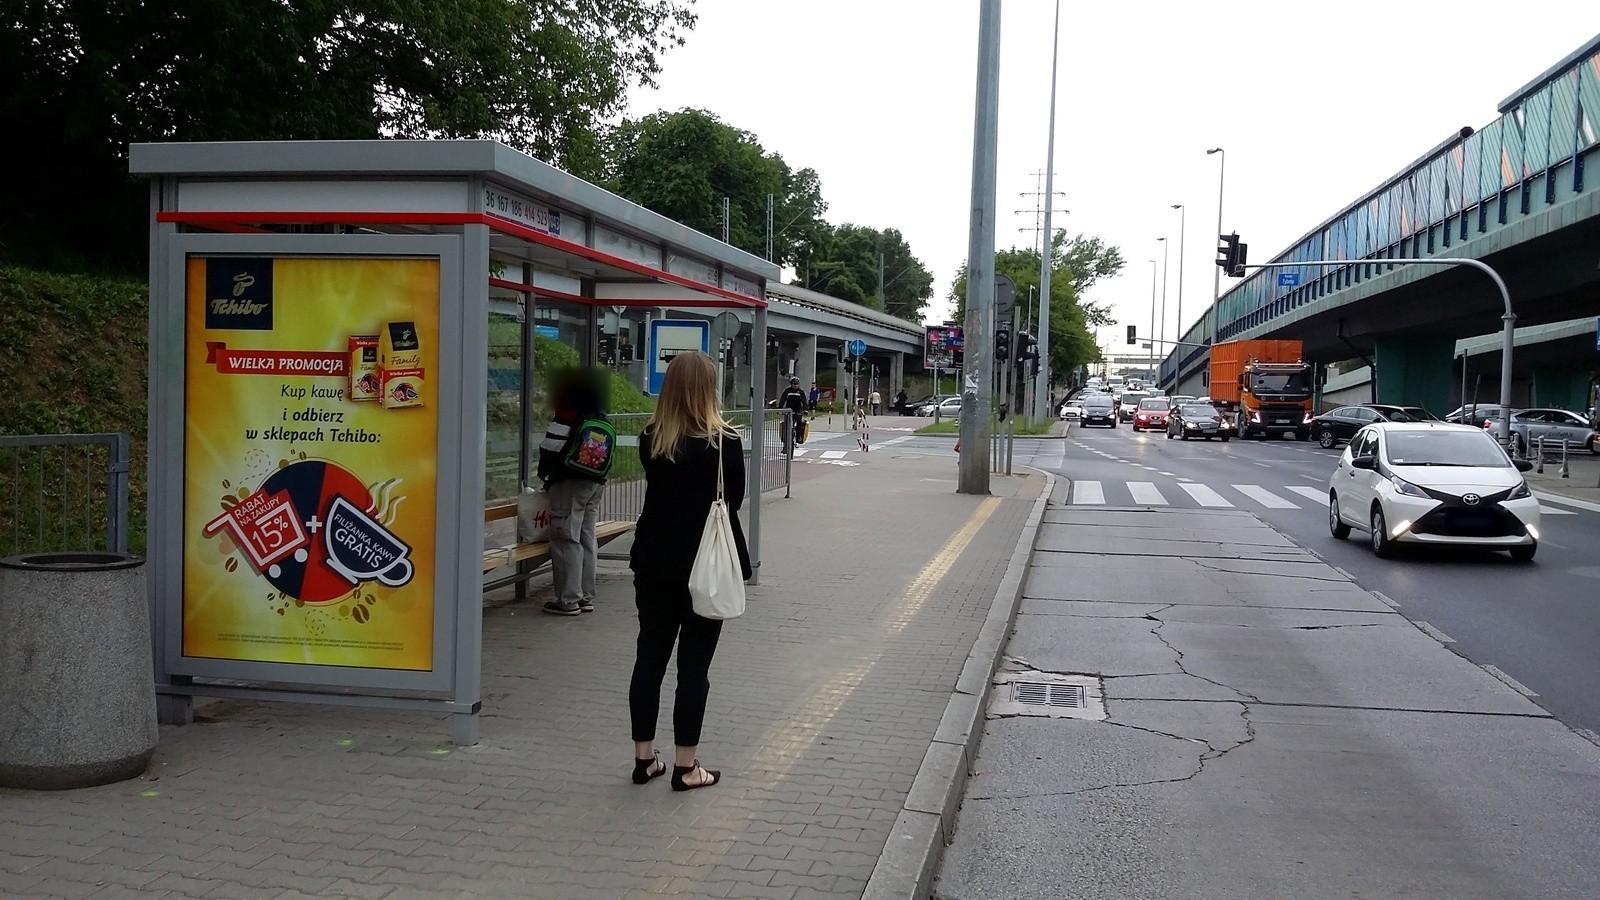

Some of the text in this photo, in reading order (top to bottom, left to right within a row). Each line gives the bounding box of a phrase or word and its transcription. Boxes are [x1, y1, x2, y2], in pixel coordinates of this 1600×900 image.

[498, 194, 508, 212] 167
[524, 205, 534, 222] 414
[536, 208, 547, 226] 523
[210, 299, 268, 315] Tchibo
[228, 356, 344, 373] WIELKA PROMOCJA
[281, 384, 344, 402] Kup kawę
[282, 408, 344, 423] i odbierz
[246, 427, 382, 443] w sklepach Tchibo:
[234, 494, 266, 518] RABAT
[240, 498, 281, 528] NA ZAKUPY
[252, 515, 288, 554] 15%
[333, 512, 395, 562] FILIŻANKA KAWY
[334, 528, 382, 570] GRATIS
